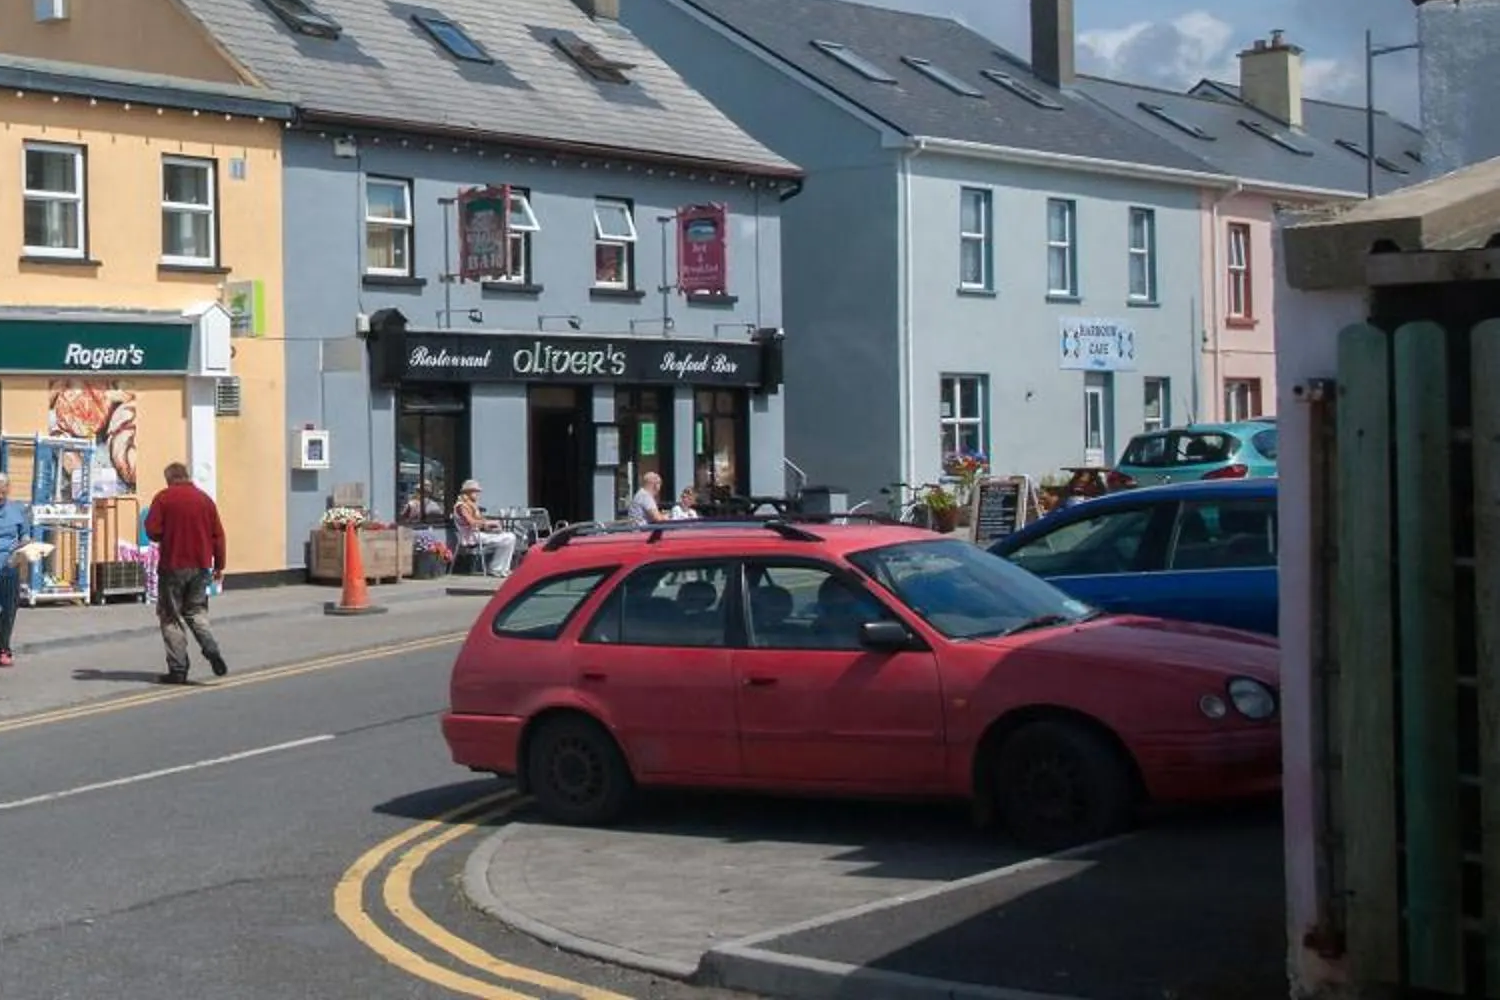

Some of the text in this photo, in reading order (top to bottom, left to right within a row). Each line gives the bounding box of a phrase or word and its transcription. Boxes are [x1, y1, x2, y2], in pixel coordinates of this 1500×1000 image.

[64, 343, 144, 369] Rogan's
[409, 345, 491, 368] Restaurant
[711, 353, 738, 373] Bar
